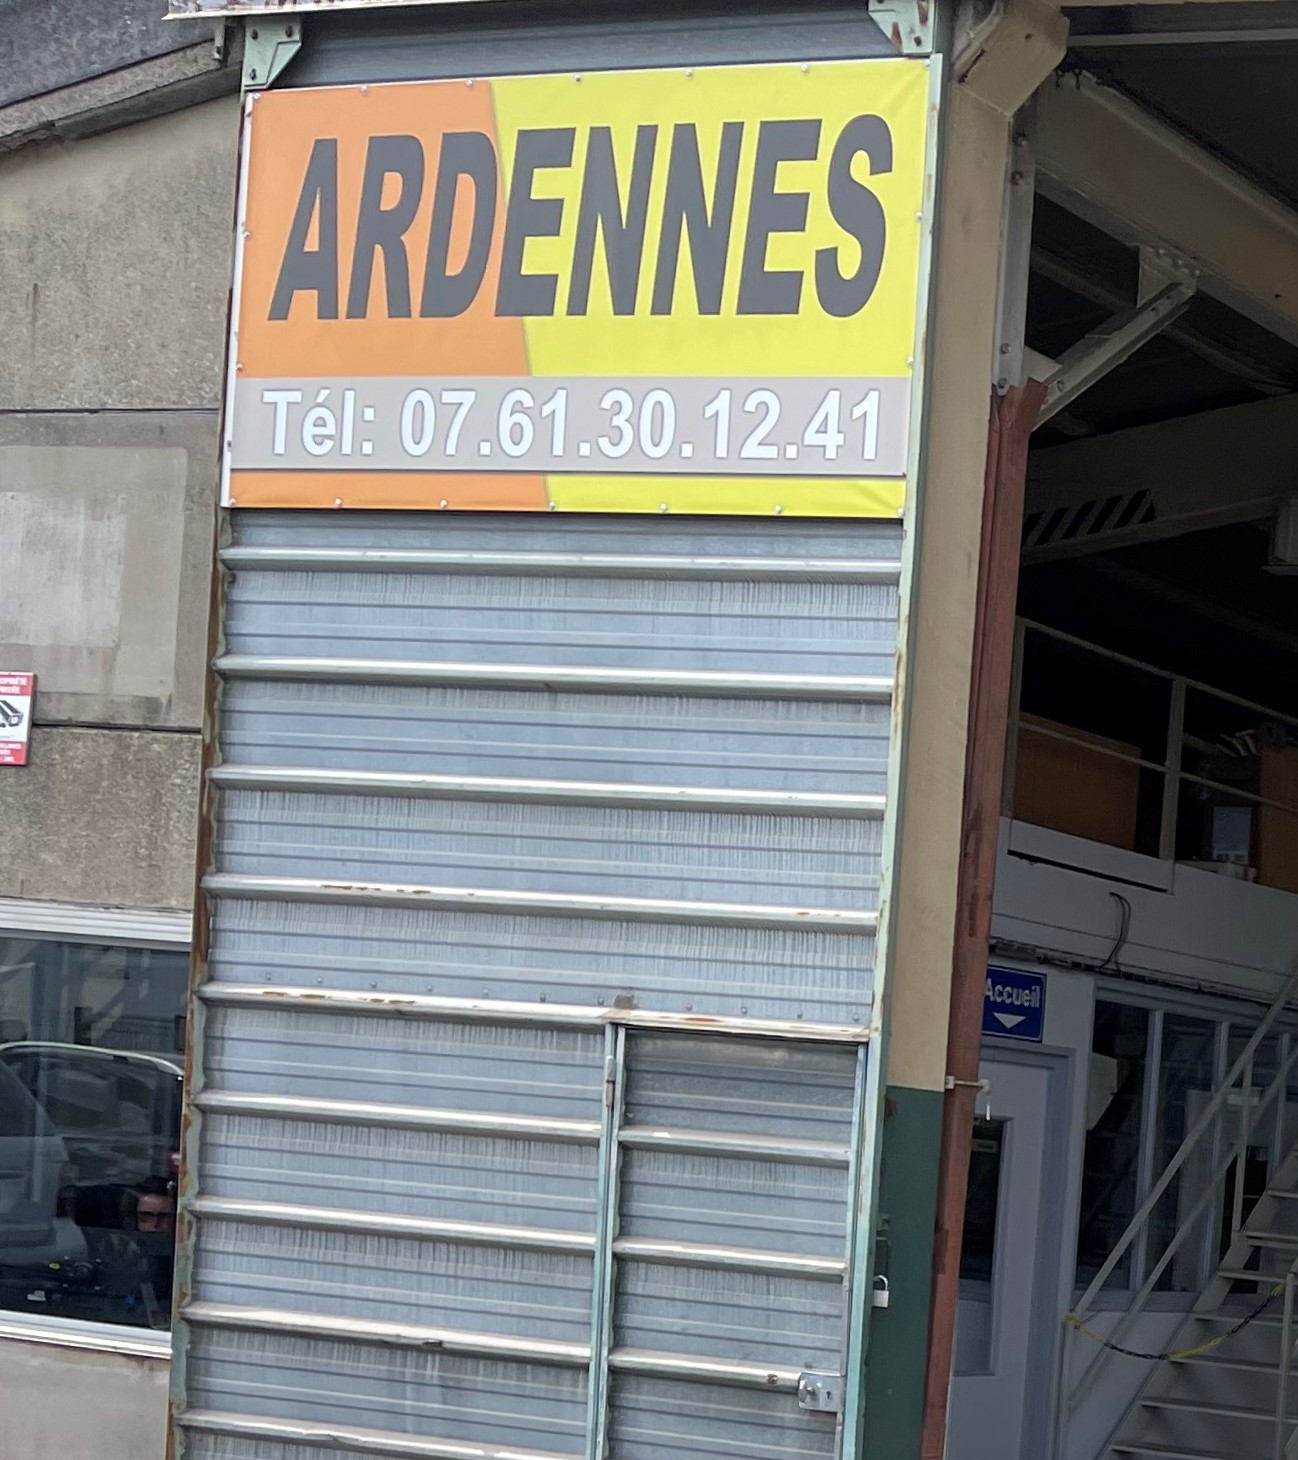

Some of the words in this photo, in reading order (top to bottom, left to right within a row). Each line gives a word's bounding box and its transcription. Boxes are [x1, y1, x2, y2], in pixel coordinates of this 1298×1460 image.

[267, 113, 893, 321] ARDENNES
[262, 387, 377, 456] Tél:
[400, 387, 882, 461] 07.61.30.12.41
[985, 977, 1040, 1008] Accueil
